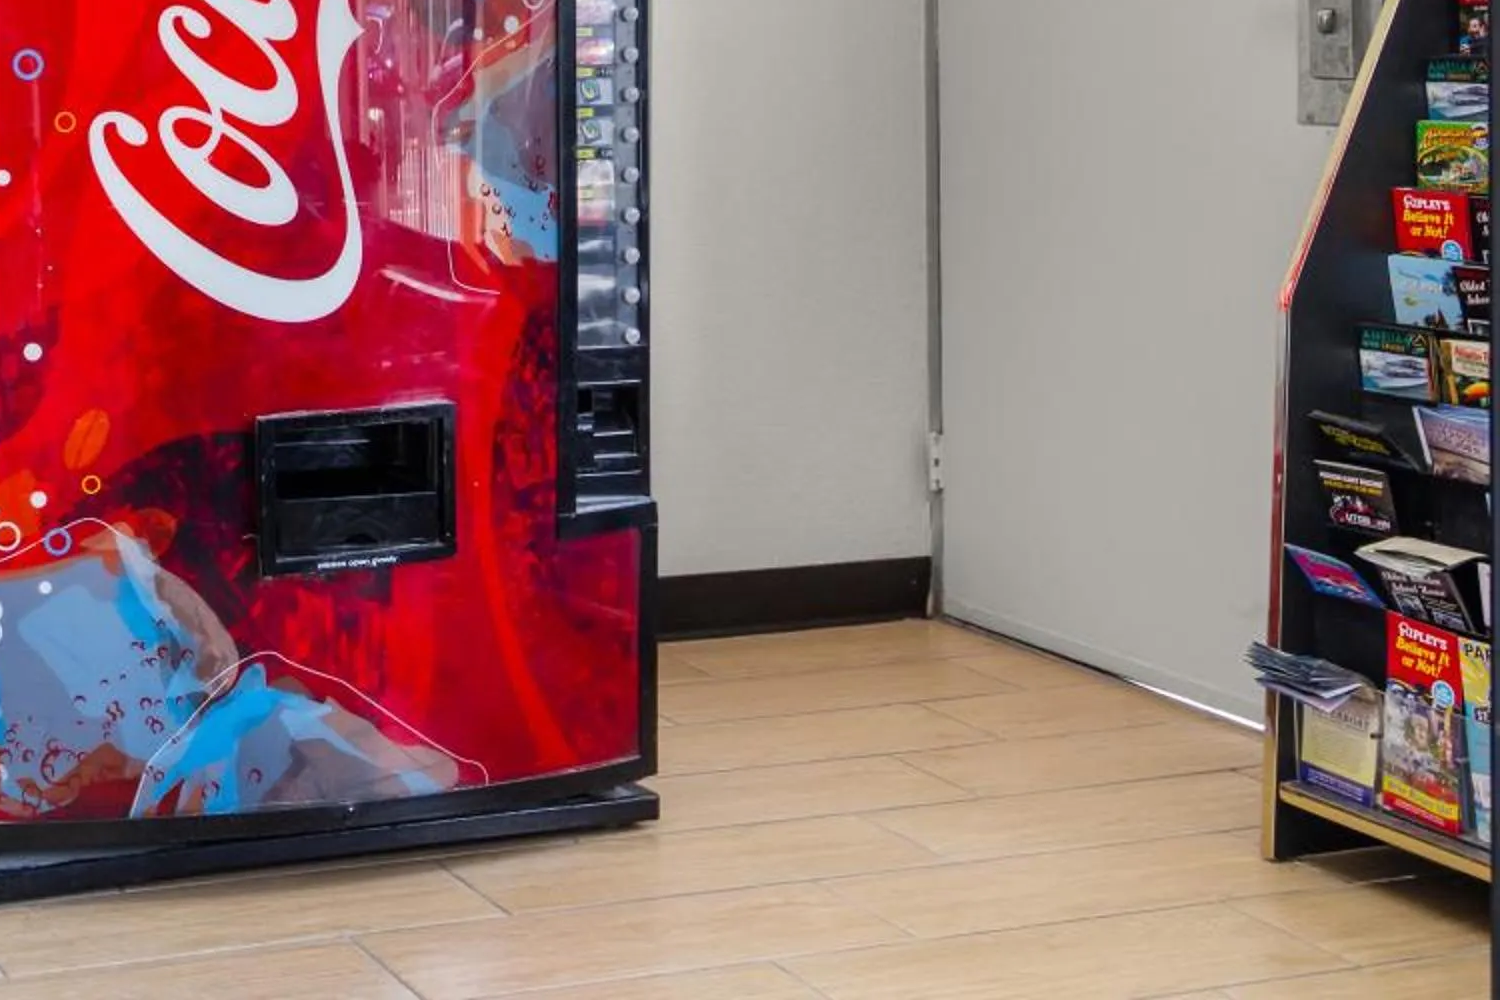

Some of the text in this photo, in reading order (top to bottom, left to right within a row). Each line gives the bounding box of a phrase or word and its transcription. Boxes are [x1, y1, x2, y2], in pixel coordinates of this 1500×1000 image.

[1403, 209, 1441, 224] Believe
[1410, 226, 1423, 237] or
[1395, 635, 1436, 661] Believe
[1401, 655, 1414, 668] or
